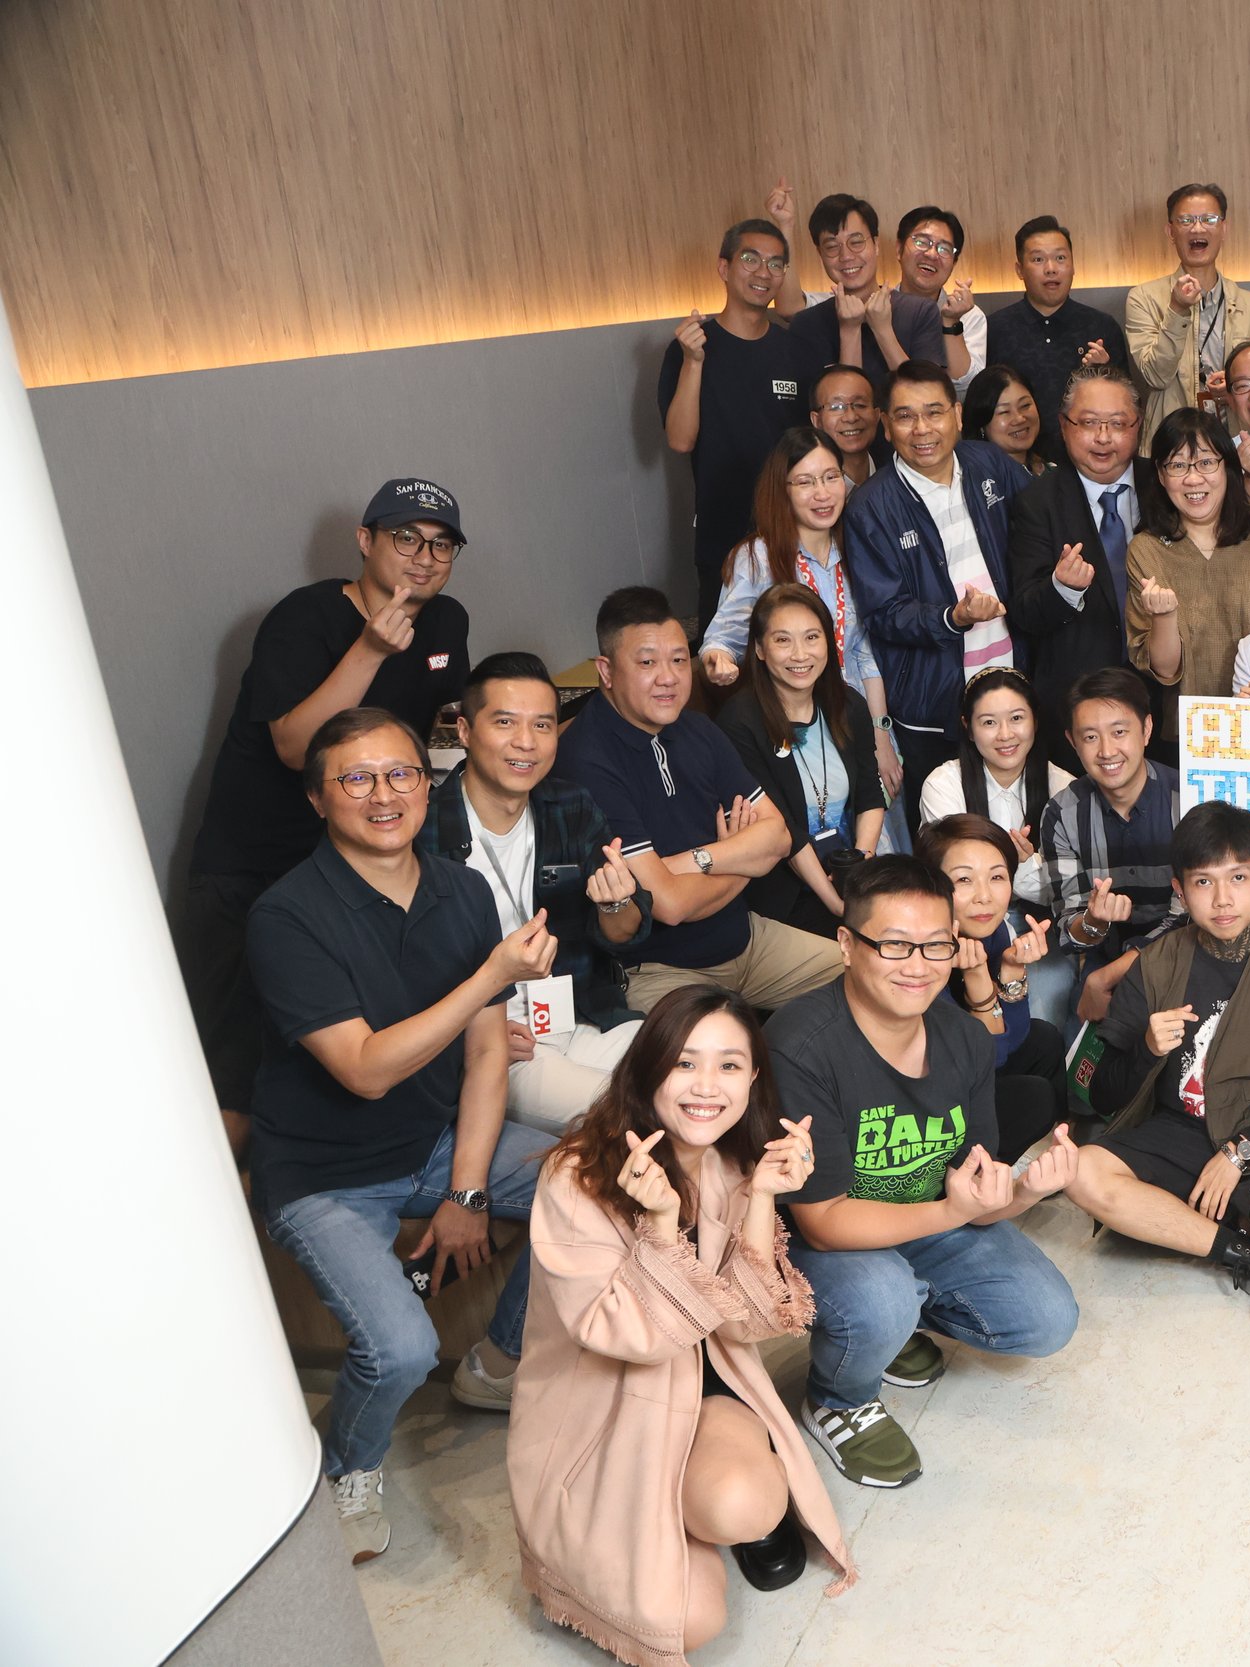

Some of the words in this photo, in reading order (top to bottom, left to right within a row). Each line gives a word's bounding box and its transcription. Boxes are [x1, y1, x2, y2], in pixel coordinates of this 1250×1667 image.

[774, 382, 796, 393] 1958
[396, 484, 413, 496] SAN
[533, 1001, 550, 1035] HOY
[860, 1104, 896, 1122] SAVE
[856, 1104, 966, 1153] BALI
[854, 1149, 888, 1169] SEA
[892, 1132, 966, 1166] TURTLES
